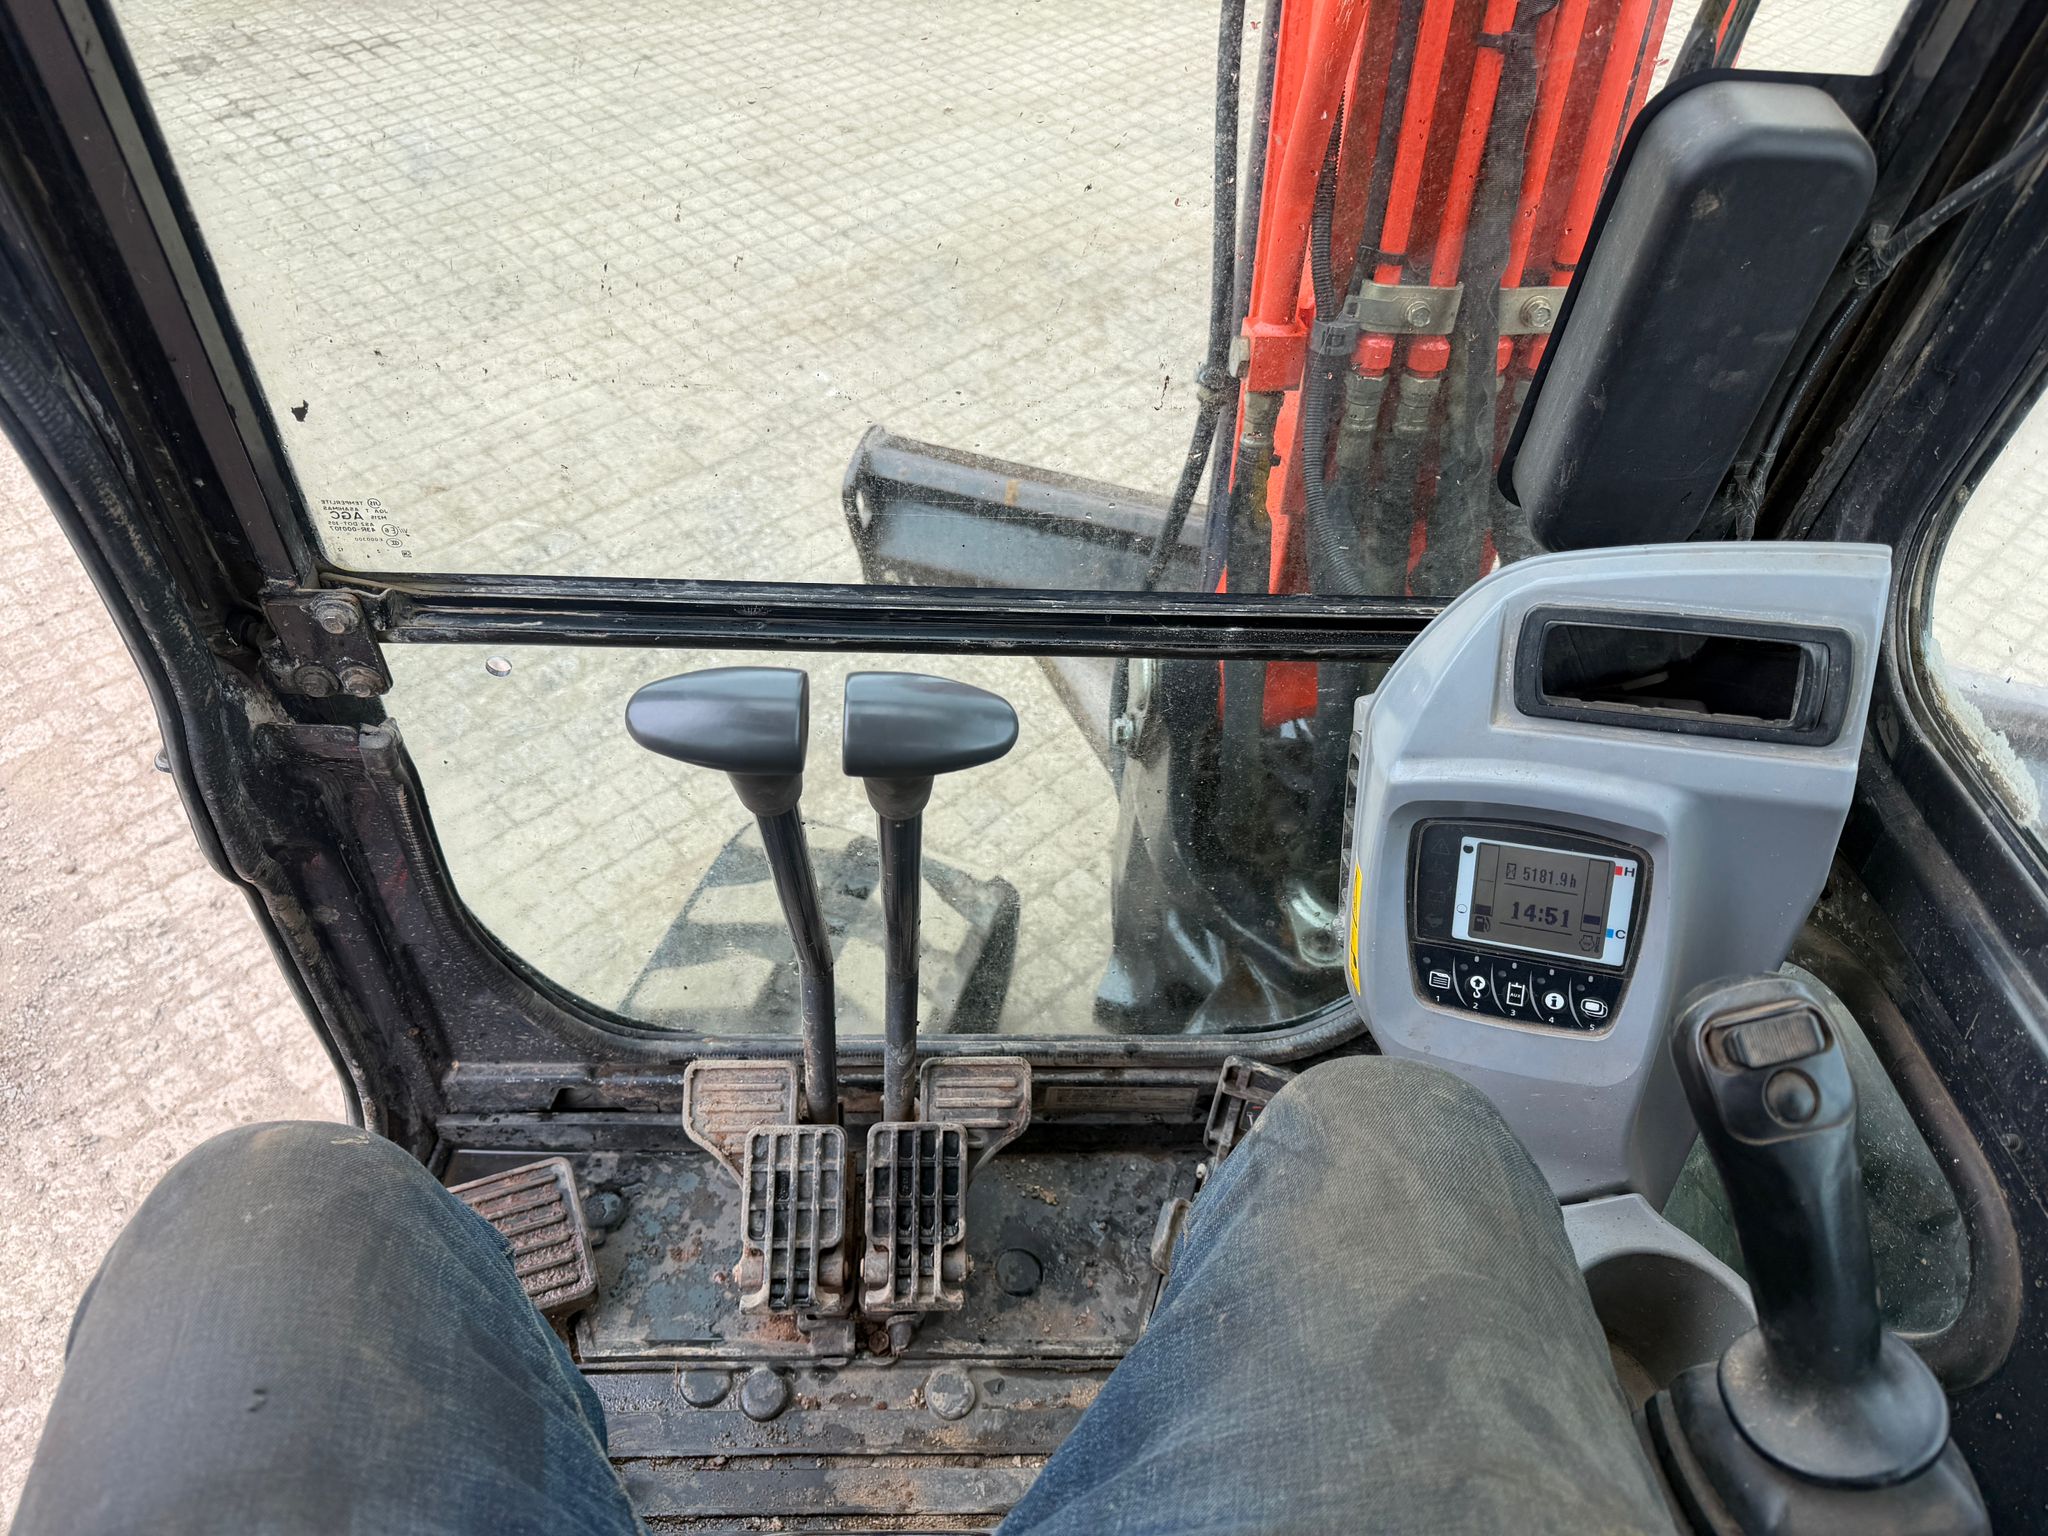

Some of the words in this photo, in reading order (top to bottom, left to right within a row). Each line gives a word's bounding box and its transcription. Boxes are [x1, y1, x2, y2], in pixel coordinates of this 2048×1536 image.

[1624, 867, 1635, 878] H
[1510, 900, 1570, 929] 14:51
[1615, 929, 1627, 940] C
[1472, 1002, 1479, 1010] 2
[1548, 1016, 1555, 1024] 4
[1589, 1023, 1595, 1031] 5
